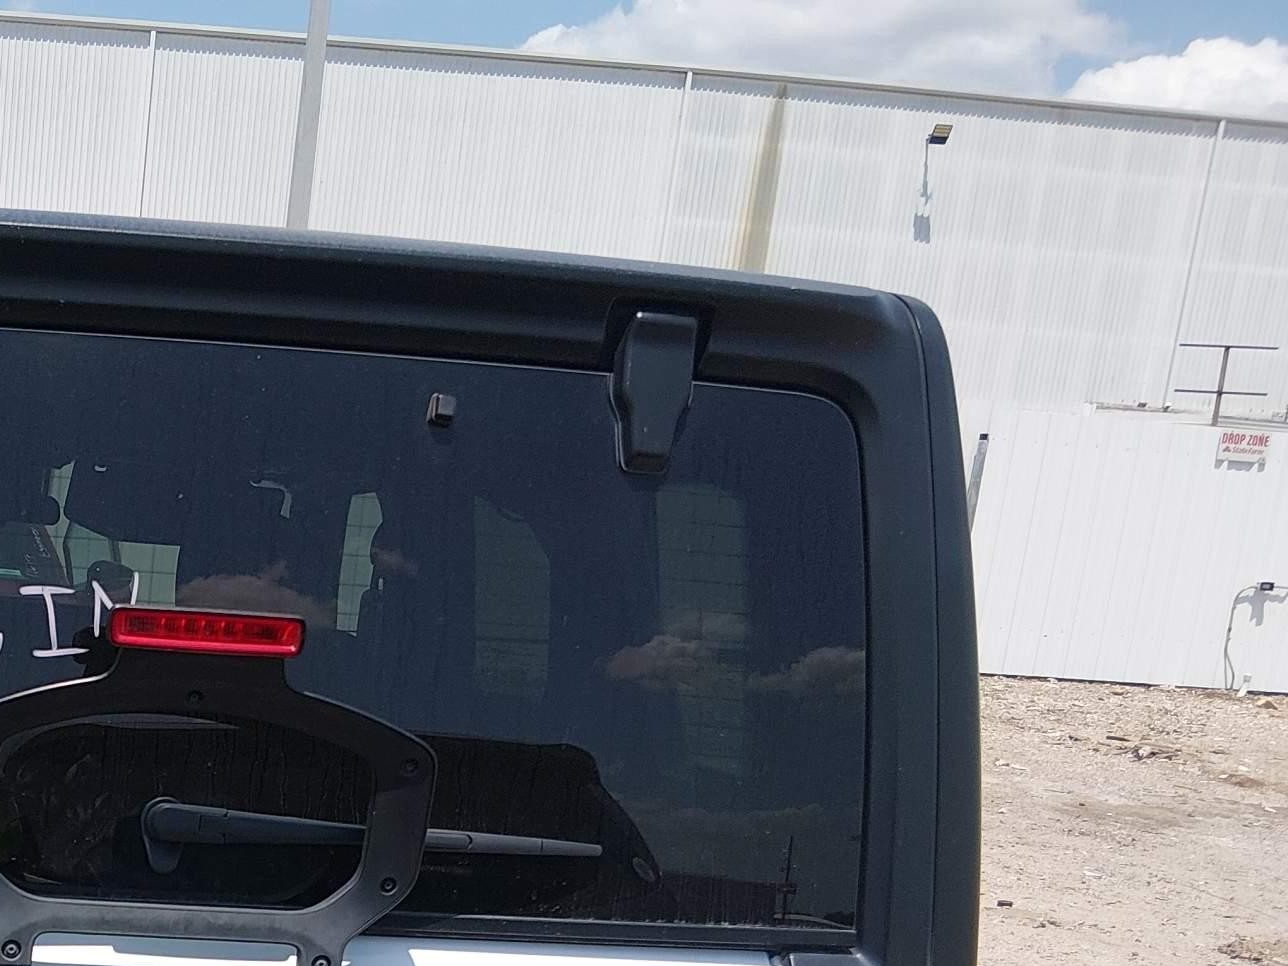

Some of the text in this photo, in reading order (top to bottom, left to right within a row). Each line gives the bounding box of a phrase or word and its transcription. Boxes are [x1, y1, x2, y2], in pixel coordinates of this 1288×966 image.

[1222, 432, 1270, 448] DROP ZONE
[19, 571, 140, 658] IN
